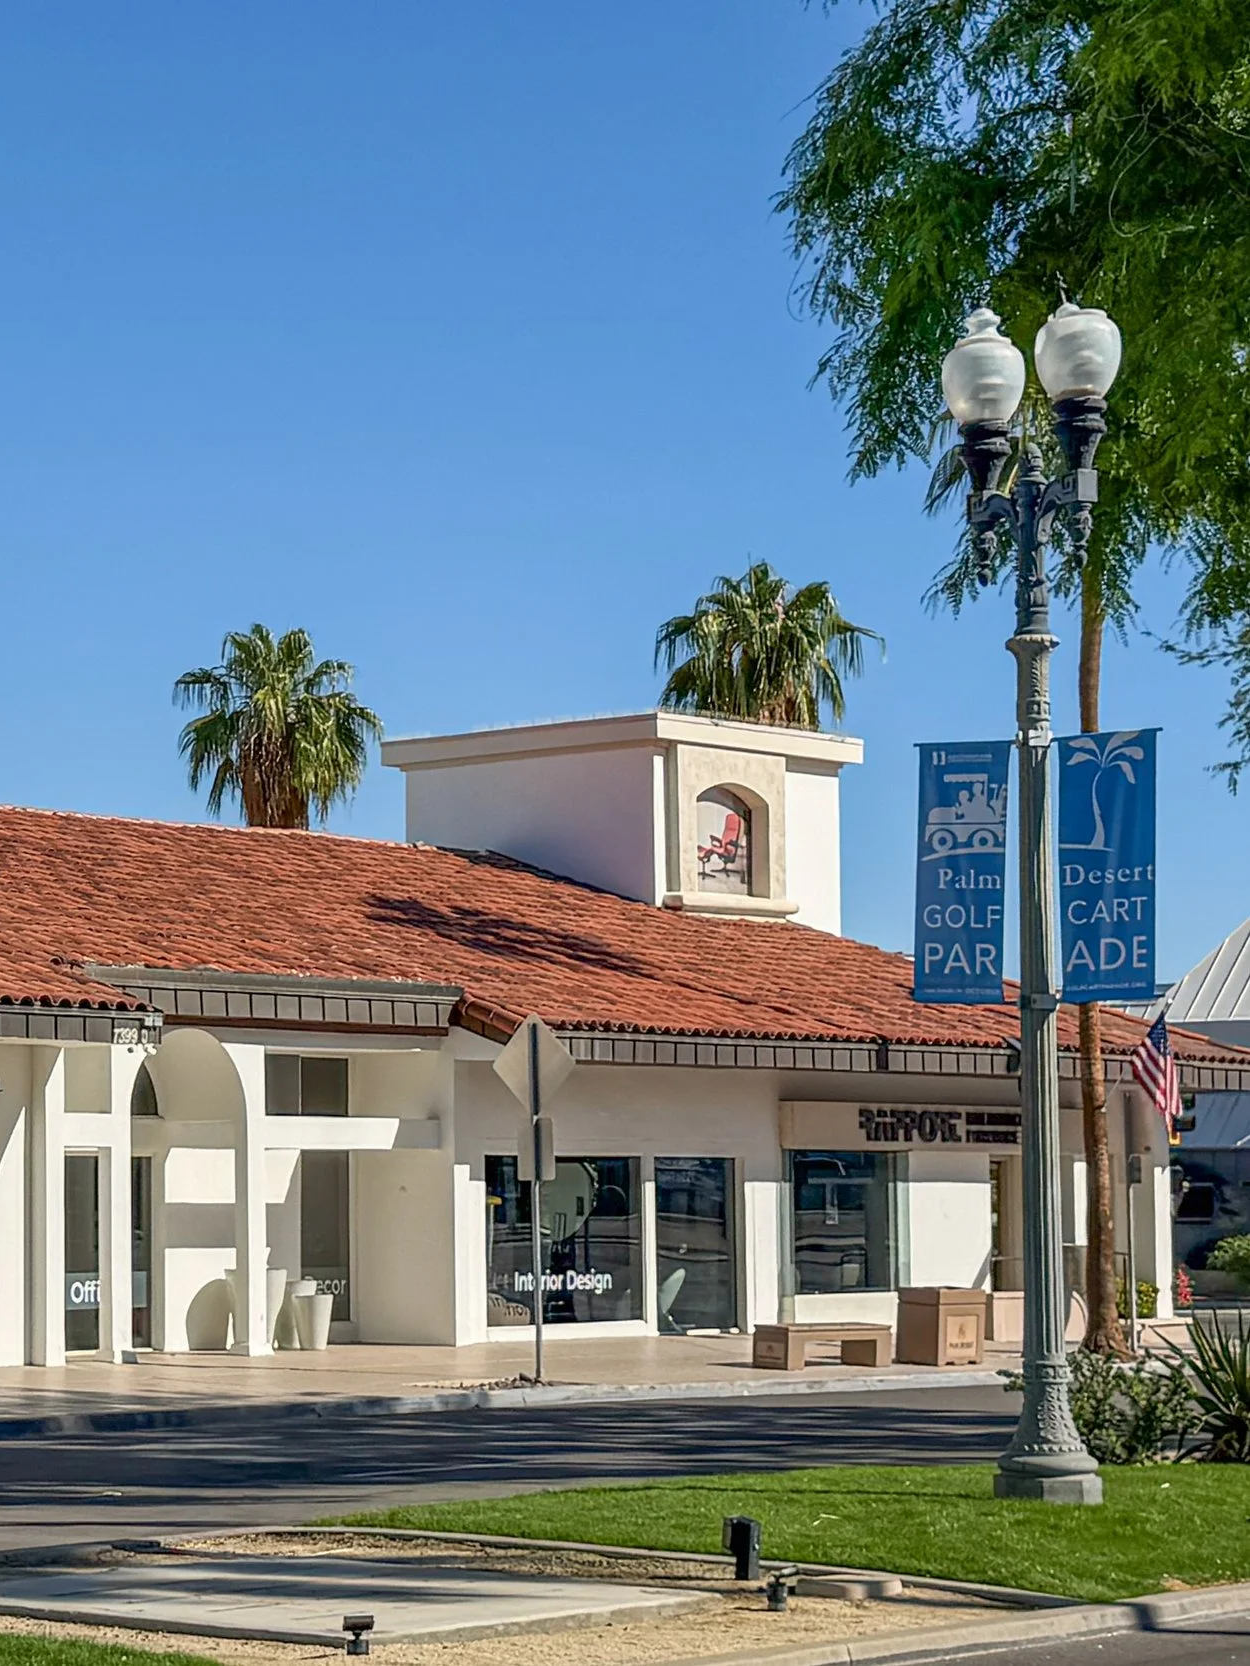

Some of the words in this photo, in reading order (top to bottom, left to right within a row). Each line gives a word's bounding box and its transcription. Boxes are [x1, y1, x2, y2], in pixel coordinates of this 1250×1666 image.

[938, 868, 1001, 889] Palm
[1062, 864, 1154, 886] Desert
[923, 904, 1002, 928] GOLF
[1067, 896, 1148, 925] CART
[924, 942, 997, 975] PAR
[1066, 935, 1147, 972] ADE
[859, 1108, 962, 1142] RAPPORT
[305, 1275, 347, 1295] ecor
[566, 1267, 613, 1295] Design
